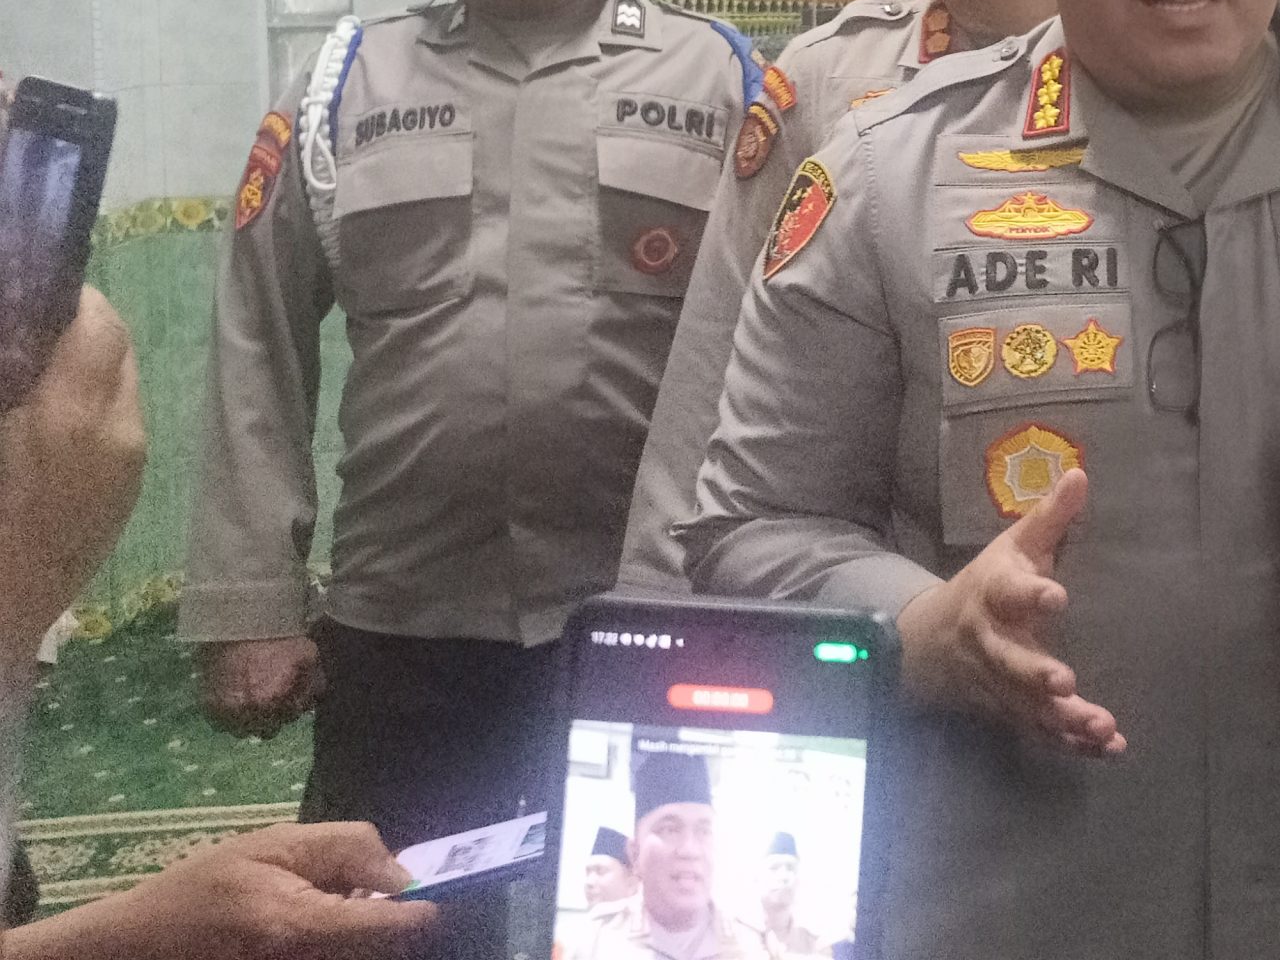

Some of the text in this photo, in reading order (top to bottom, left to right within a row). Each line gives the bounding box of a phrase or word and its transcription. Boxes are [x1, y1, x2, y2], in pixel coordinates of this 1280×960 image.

[616, 98, 716, 138] POLRI
[946, 248, 1118, 297] ADE RI
